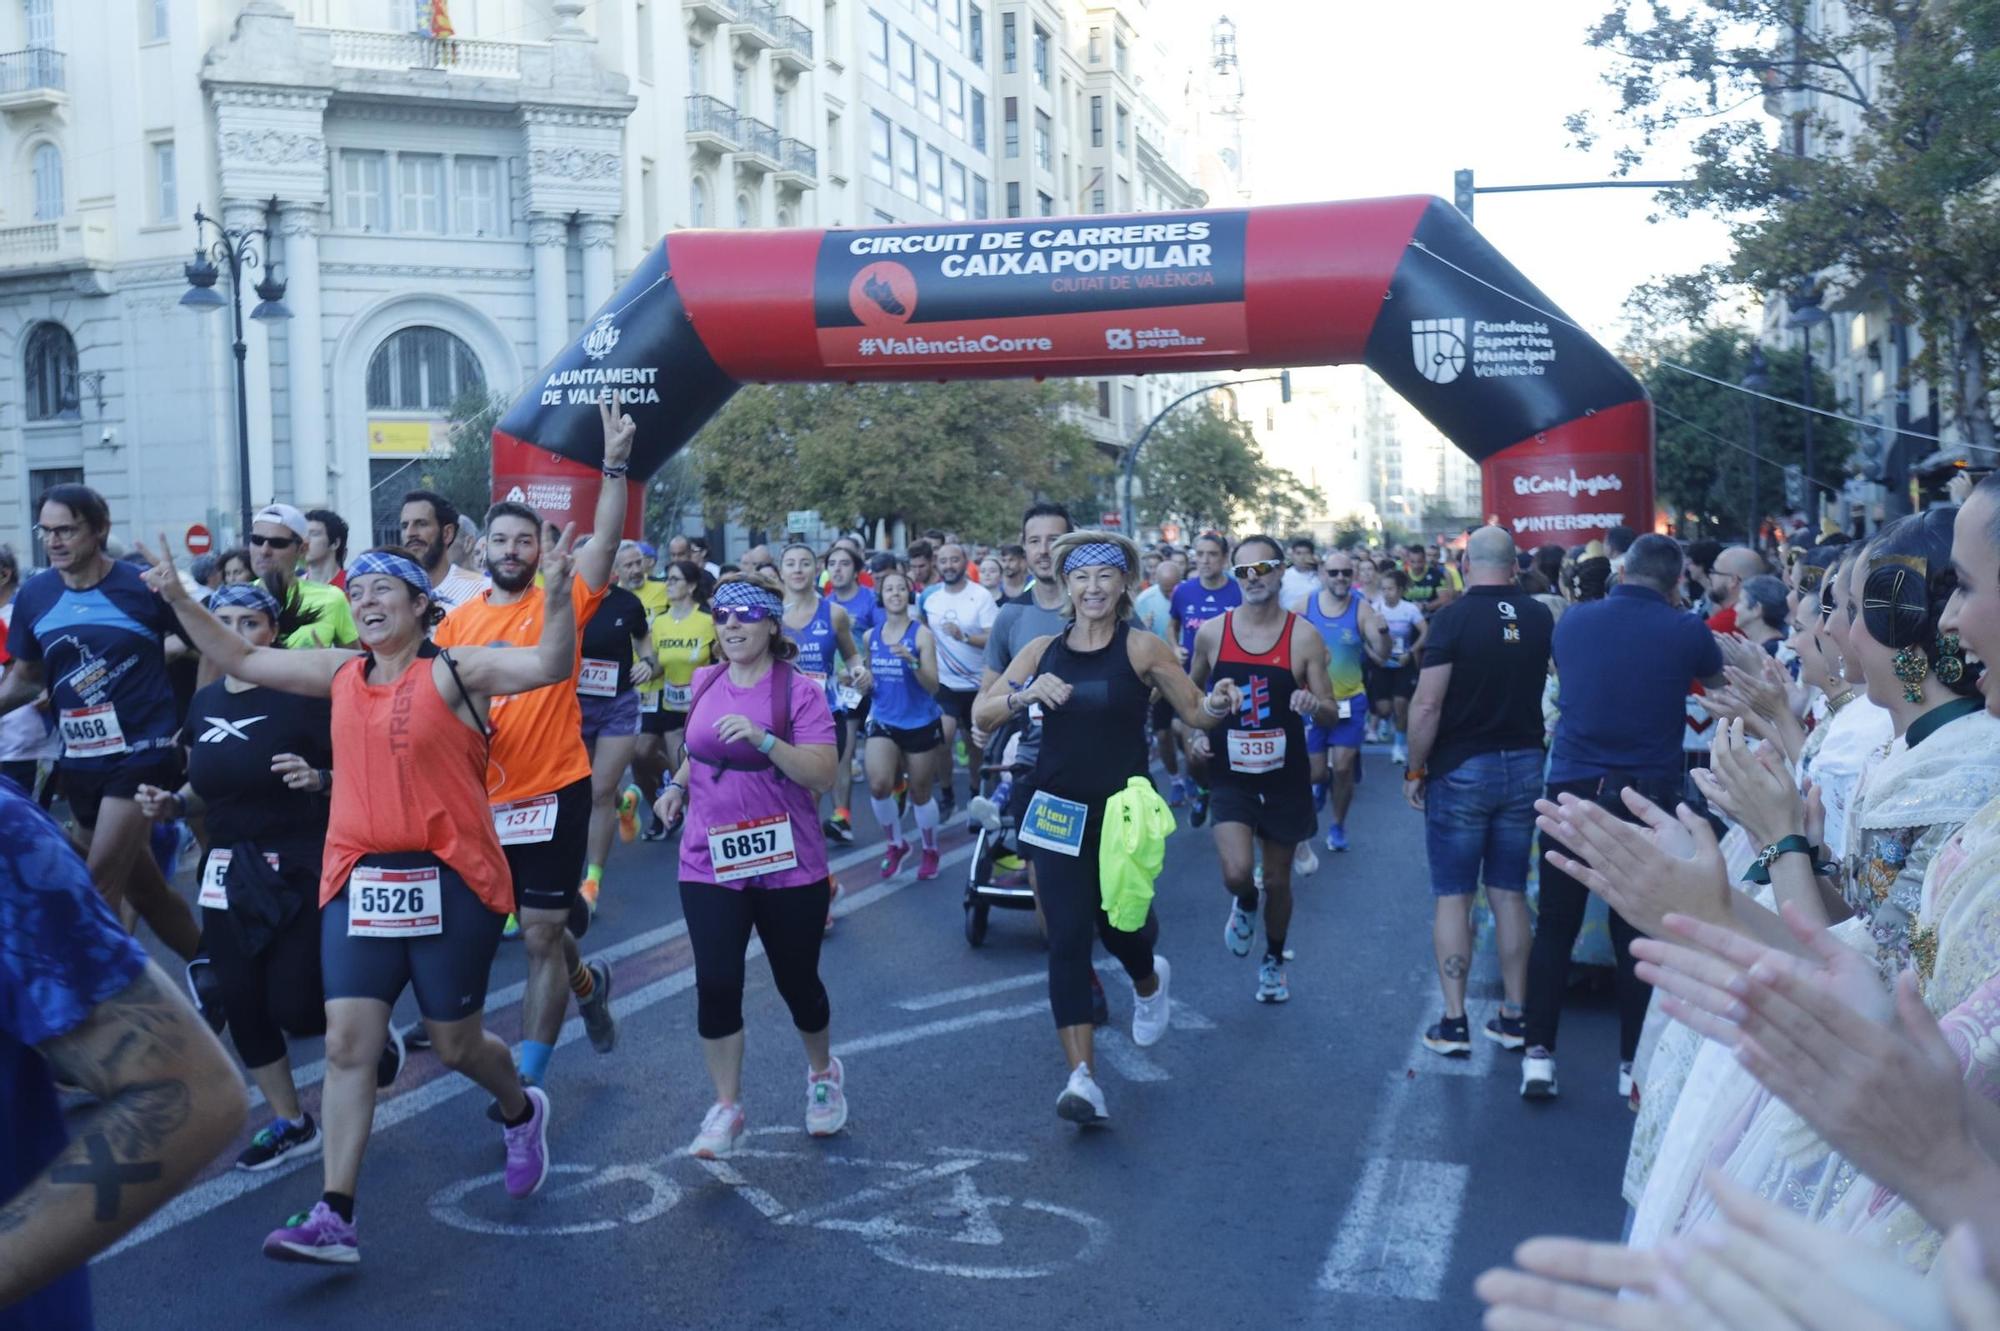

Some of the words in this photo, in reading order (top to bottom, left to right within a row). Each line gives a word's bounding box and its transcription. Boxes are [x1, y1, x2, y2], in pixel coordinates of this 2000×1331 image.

[849, 234, 975, 255] CIRCUIT
[980, 232, 1024, 250] DE
[1029, 222, 1211, 248] CARRERES
[1051, 244, 1212, 273] POPULAR
[1052, 276, 1106, 293] CIUTAT
[1110, 275, 1132, 290] DE
[1135, 270, 1215, 288] VALÈNCIA
[1136, 327, 1180, 339] caixa
[1472, 320, 1549, 334] Fundació
[858, 335, 1052, 356] #ValènciaCorre
[1136, 336, 1206, 349] popular
[1472, 334, 1553, 350] Esportiva
[1473, 348, 1556, 366] Municipal
[545, 367, 659, 388] AJUNTAMENT
[1473, 363, 1545, 378] València
[541, 389, 563, 405] DE
[1528, 513, 1624, 531] INTERSPORT
[64, 717, 108, 740] 6468
[1240, 741, 1275, 755] 338
[1035, 804, 1048, 818] Al
[1047, 808, 1068, 824] teu
[722, 830, 776, 859] 6857
[361, 887, 424, 913] 5526
